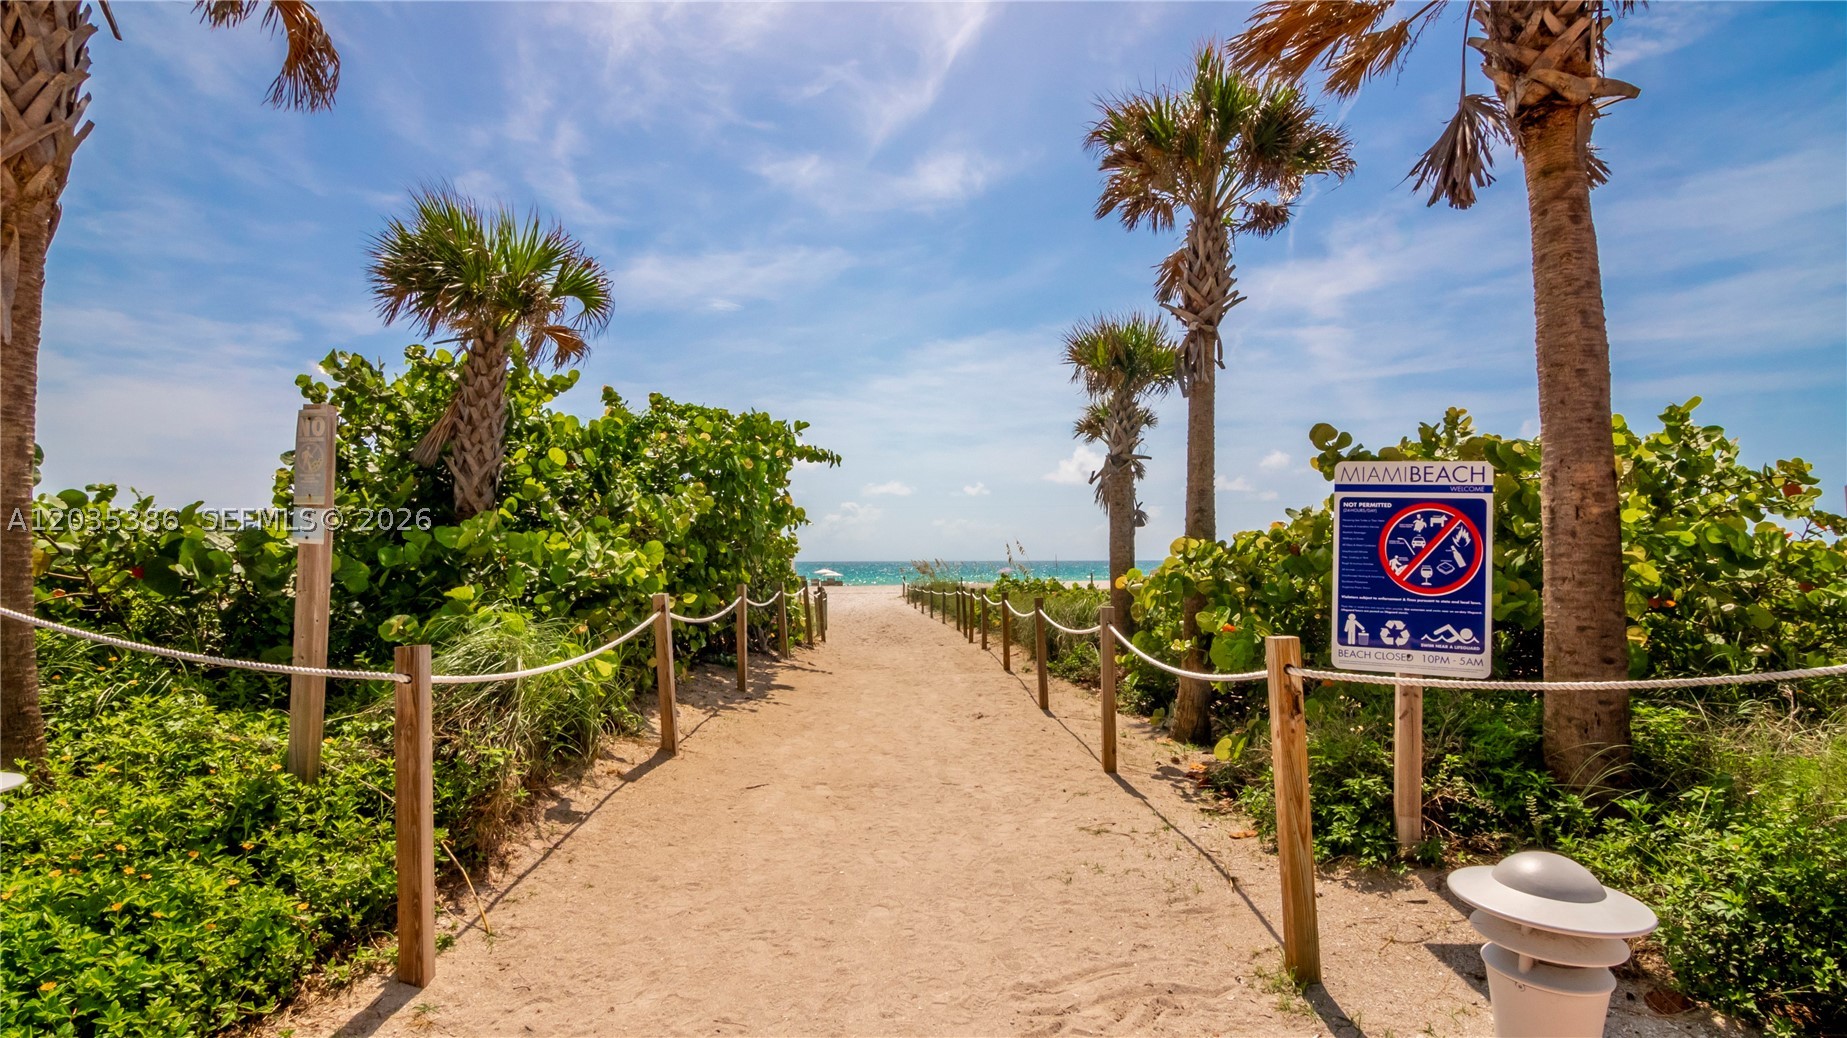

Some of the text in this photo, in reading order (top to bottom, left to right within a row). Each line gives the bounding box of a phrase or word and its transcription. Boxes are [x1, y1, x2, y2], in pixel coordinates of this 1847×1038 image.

[299, 416, 326, 437] NO
[1338, 649, 1371, 659] BEACH
[1374, 651, 1414, 662] CLOSED
[1422, 654, 1450, 664] 10PM
[1459, 657, 1484, 667] 5AM
